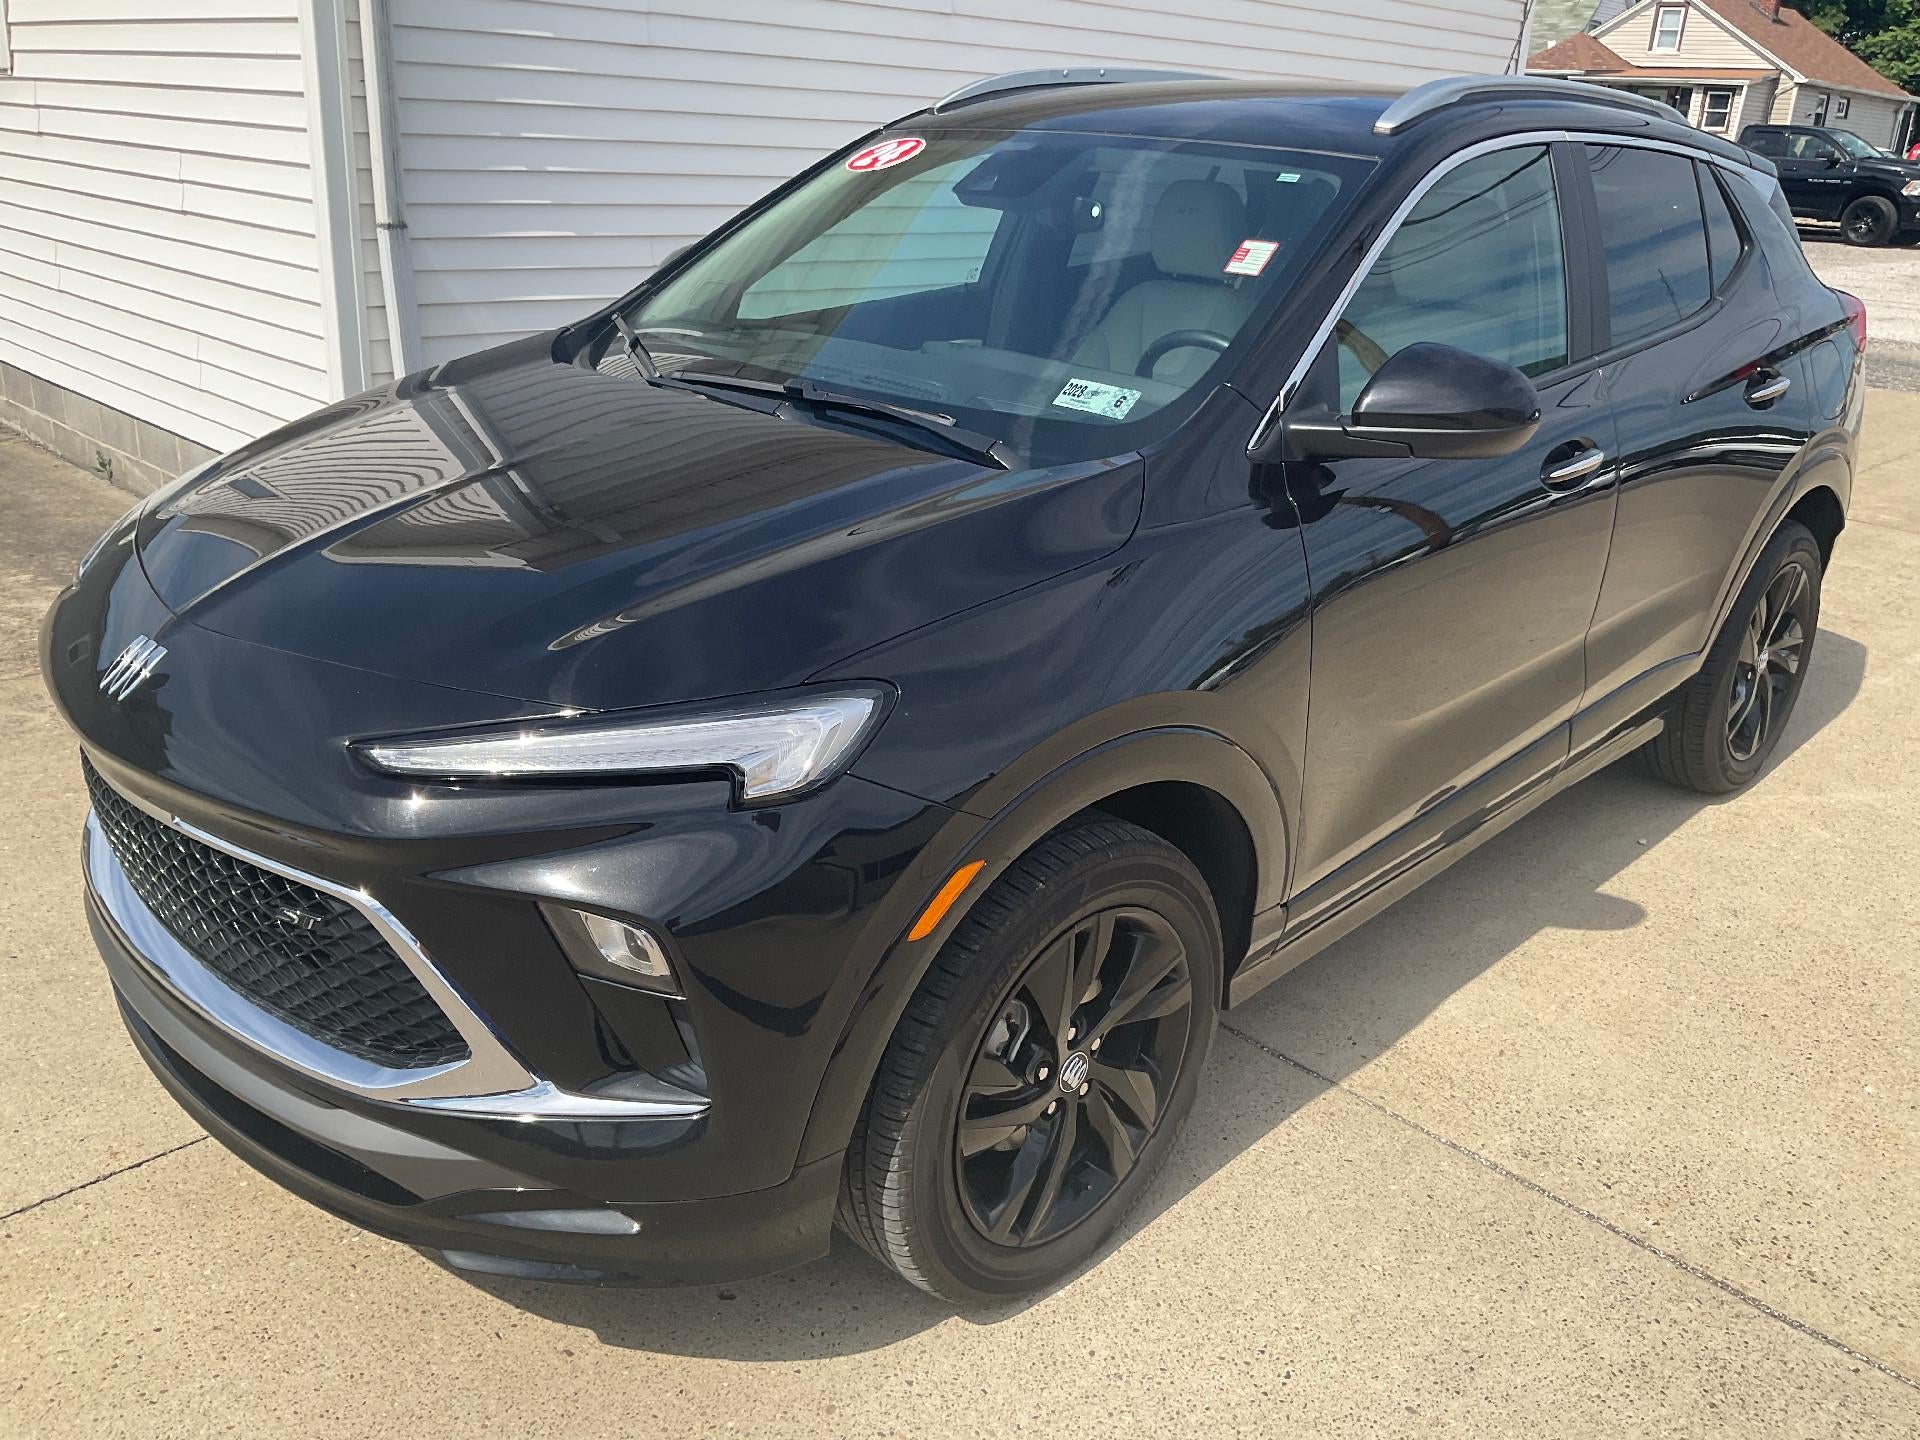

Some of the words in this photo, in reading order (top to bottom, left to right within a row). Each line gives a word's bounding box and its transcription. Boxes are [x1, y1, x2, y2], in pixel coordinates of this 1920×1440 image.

[852, 141, 918, 169] 24
[1113, 395, 1128, 409] 6
[275, 907, 323, 930] ST
